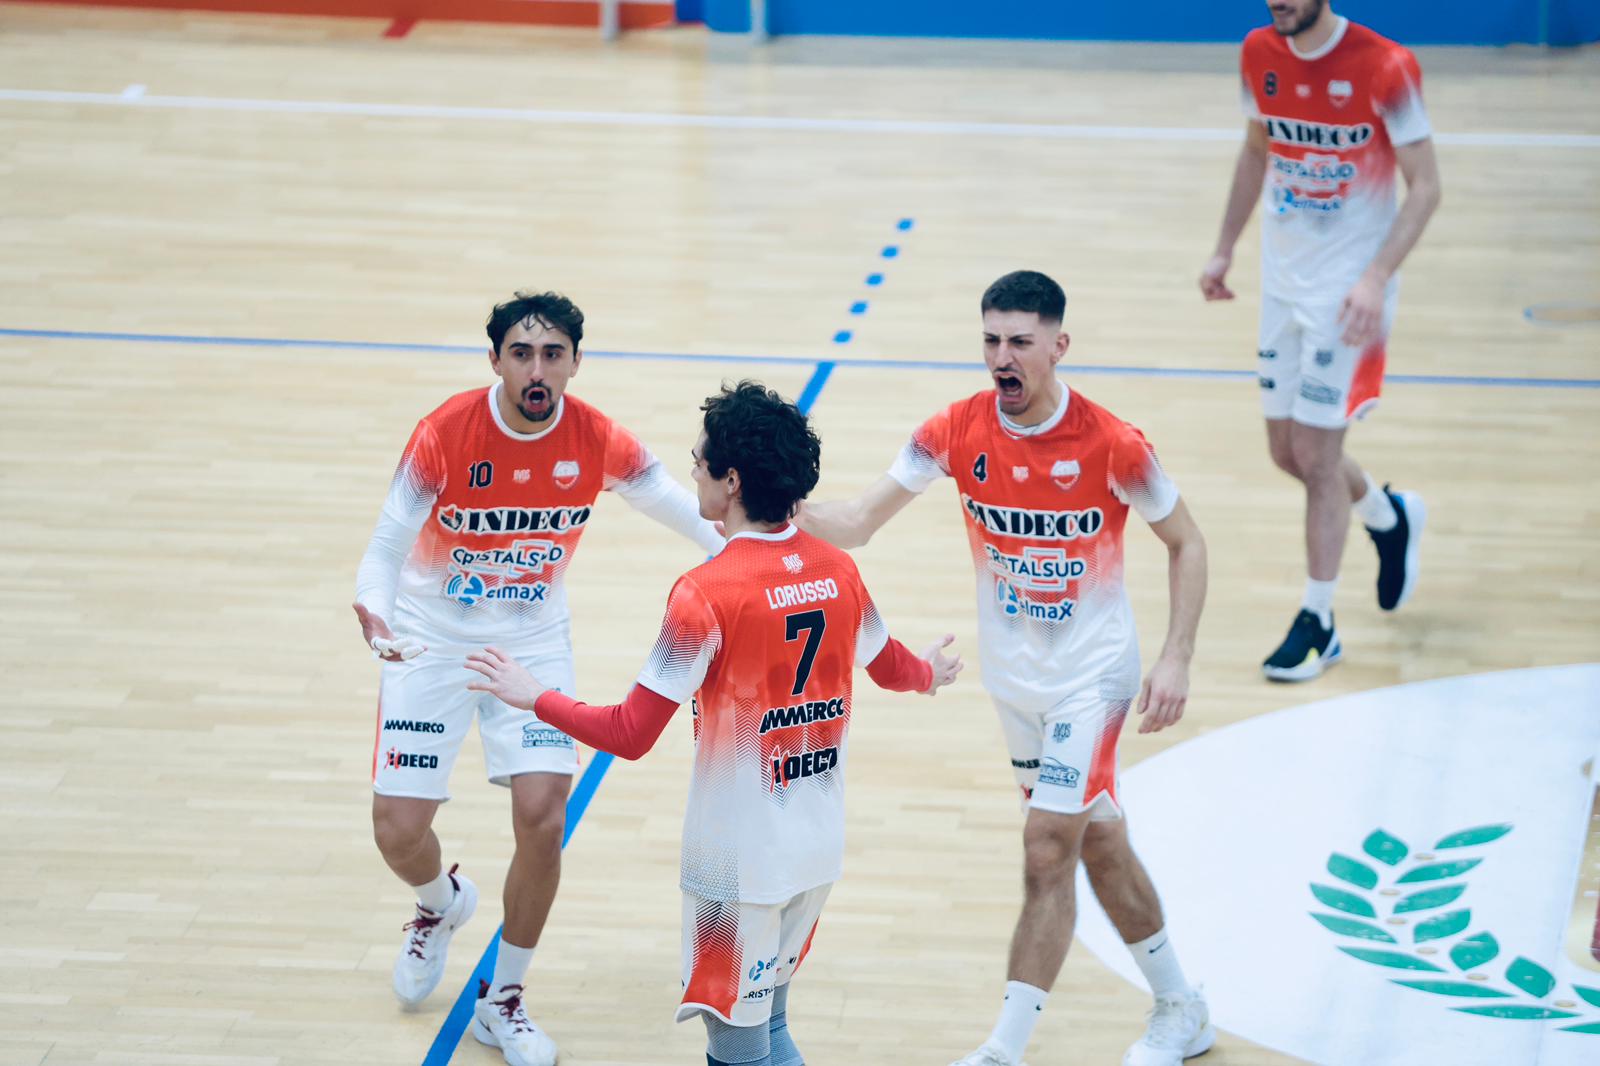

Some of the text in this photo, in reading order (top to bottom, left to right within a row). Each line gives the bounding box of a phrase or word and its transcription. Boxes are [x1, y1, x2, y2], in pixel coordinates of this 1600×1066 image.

[1267, 118, 1370, 147] INDECO
[468, 460, 494, 488] 10
[973, 453, 988, 483] 4
[467, 506, 591, 532] INDECO
[976, 504, 1102, 538] INDECO
[452, 546, 563, 567] CRISTALSD
[764, 577, 839, 610] LORUSSO
[1020, 600, 1074, 620] lmax
[784, 609, 827, 697] 7
[383, 719, 445, 734] AMMERCO
